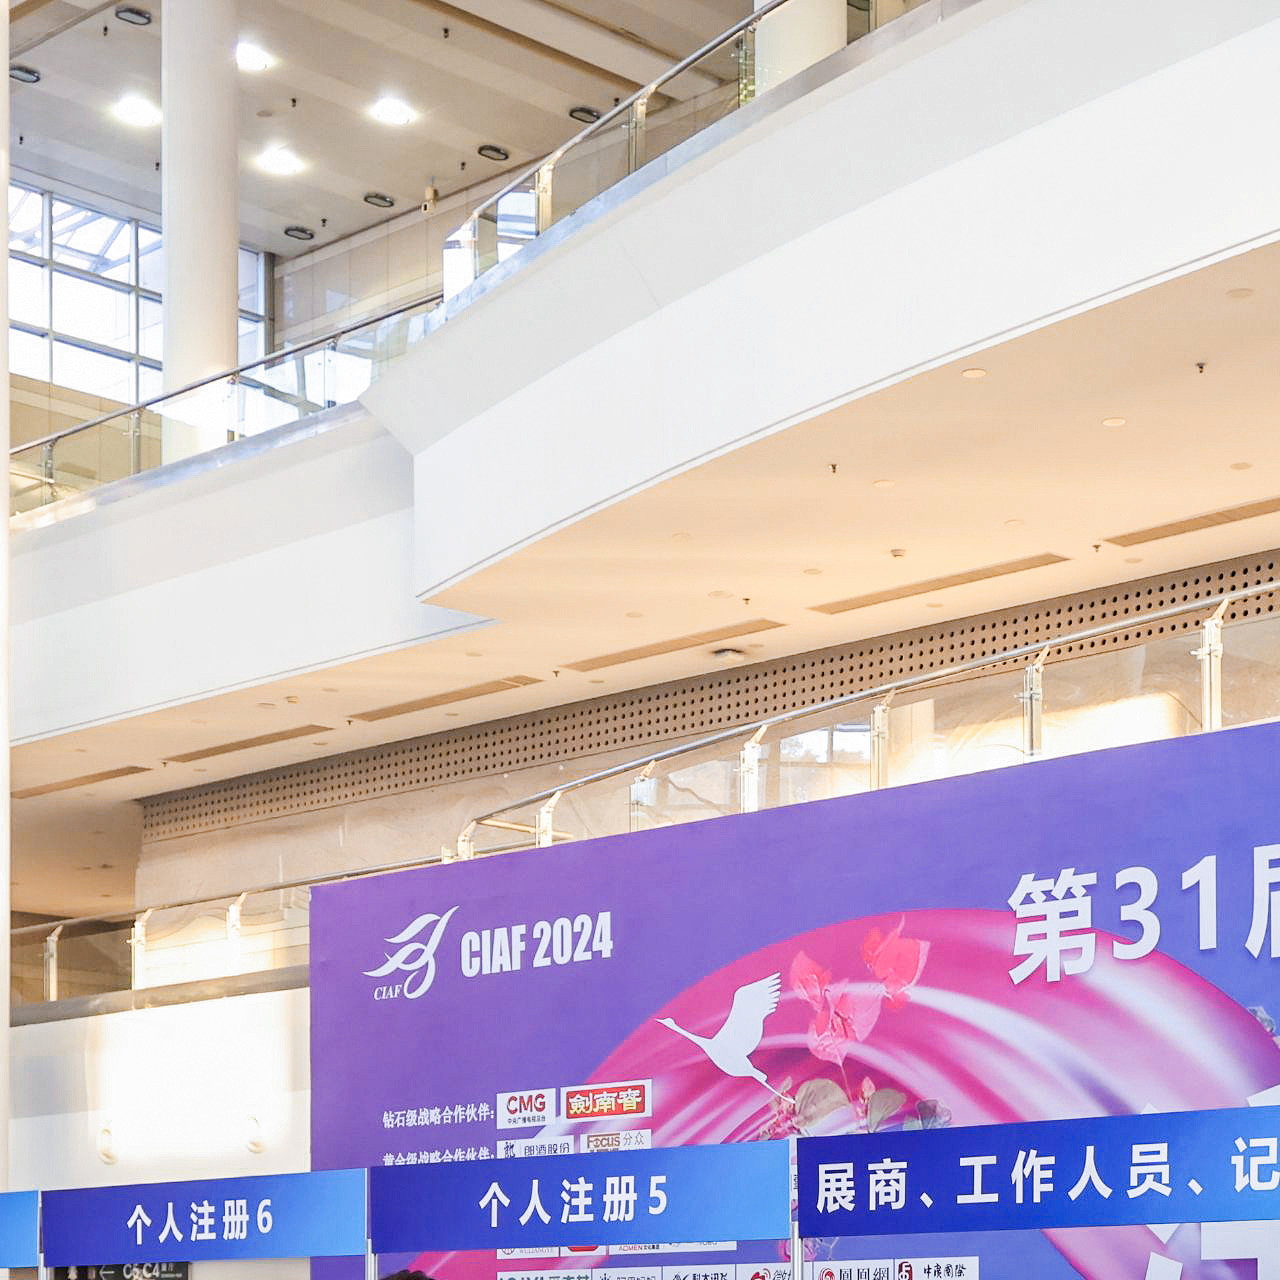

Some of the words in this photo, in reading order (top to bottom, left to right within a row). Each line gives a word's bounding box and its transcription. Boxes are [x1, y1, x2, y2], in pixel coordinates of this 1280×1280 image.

[461, 923, 527, 978] CIAF
[532, 910, 614, 968] 2024
[373, 984, 402, 1000] CIAF
[506, 1093, 546, 1115] CMG
[623, 1131, 645, 1146] 分众
[478, 1175, 668, 1228] 个人注册5
[126, 1198, 274, 1245] 个人注册6
